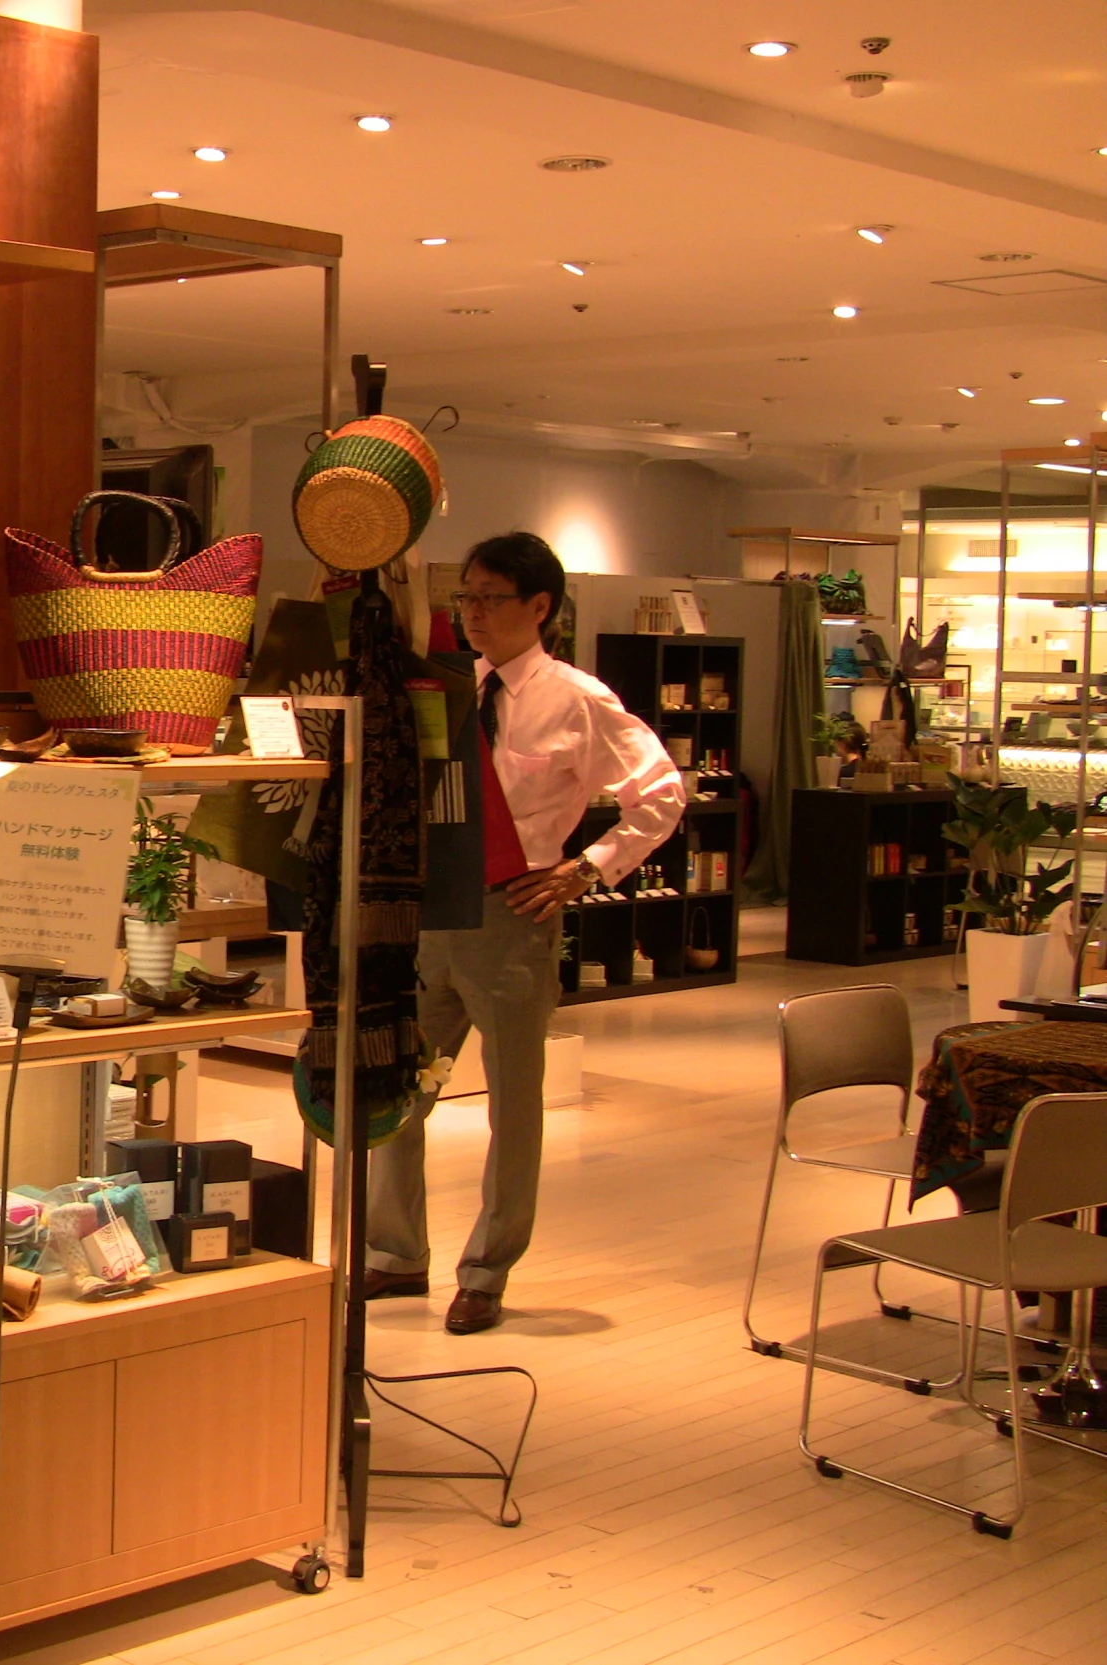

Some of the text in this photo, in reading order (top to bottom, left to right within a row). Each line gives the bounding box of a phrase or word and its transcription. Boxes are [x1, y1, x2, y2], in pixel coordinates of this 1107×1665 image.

[7, 780, 119, 799] 夏のリビングフェスタ
[20, 844, 81, 861] 無料体験
